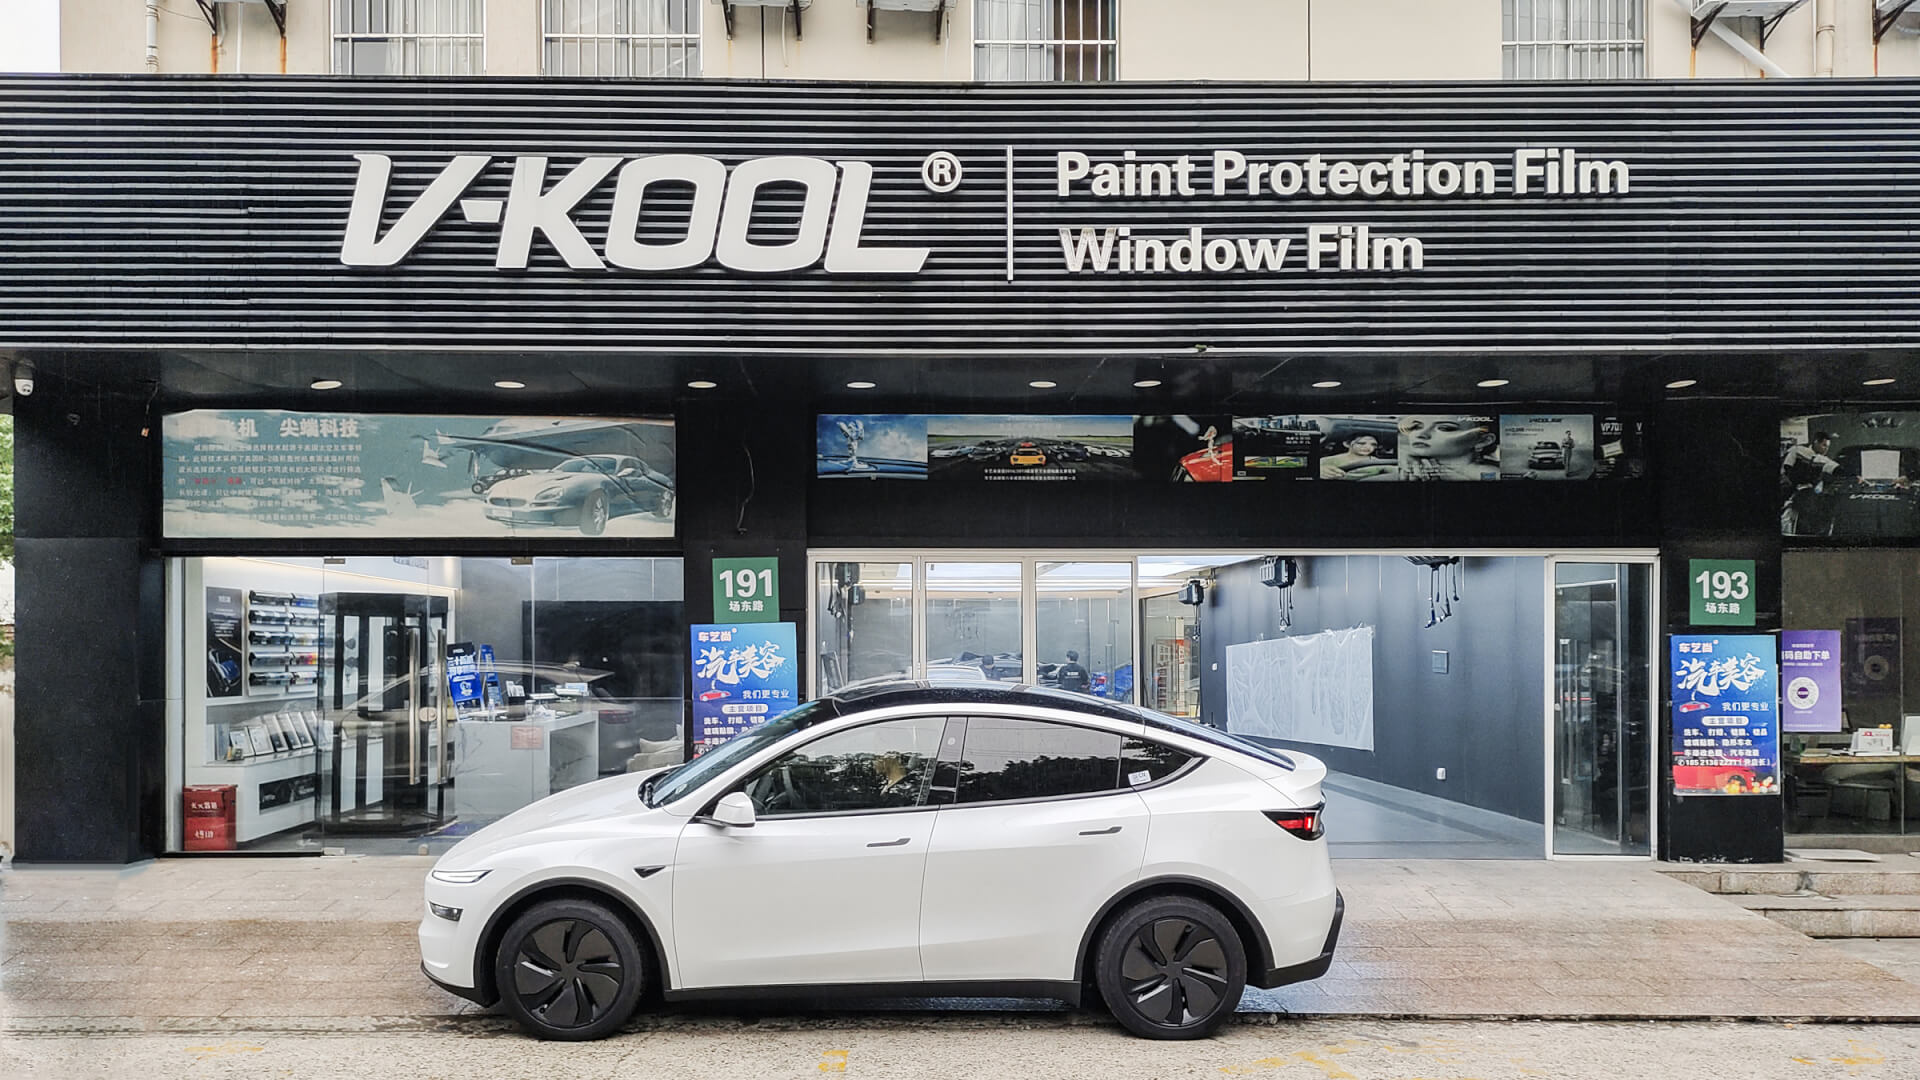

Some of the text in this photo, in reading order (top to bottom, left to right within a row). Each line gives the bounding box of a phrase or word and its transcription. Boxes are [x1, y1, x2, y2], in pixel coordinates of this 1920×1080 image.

[1056, 148, 1630, 197] Paint Protection Film
[340, 153, 931, 273] V-KOOL
[1059, 225, 1424, 272] Window Film
[280, 418, 359, 437] 尖端科技
[719, 568, 773, 598] 191
[1695, 570, 1749, 600] 193
[729, 601, 764, 612] 场东路
[1704, 602, 1740, 614] 场东路
[695, 640, 787, 687] 汽车美容
[1675, 652, 1767, 699] 汽车美容
[742, 689, 790, 699] 我们更专业
[1721, 702, 1769, 711] 我们更专业
